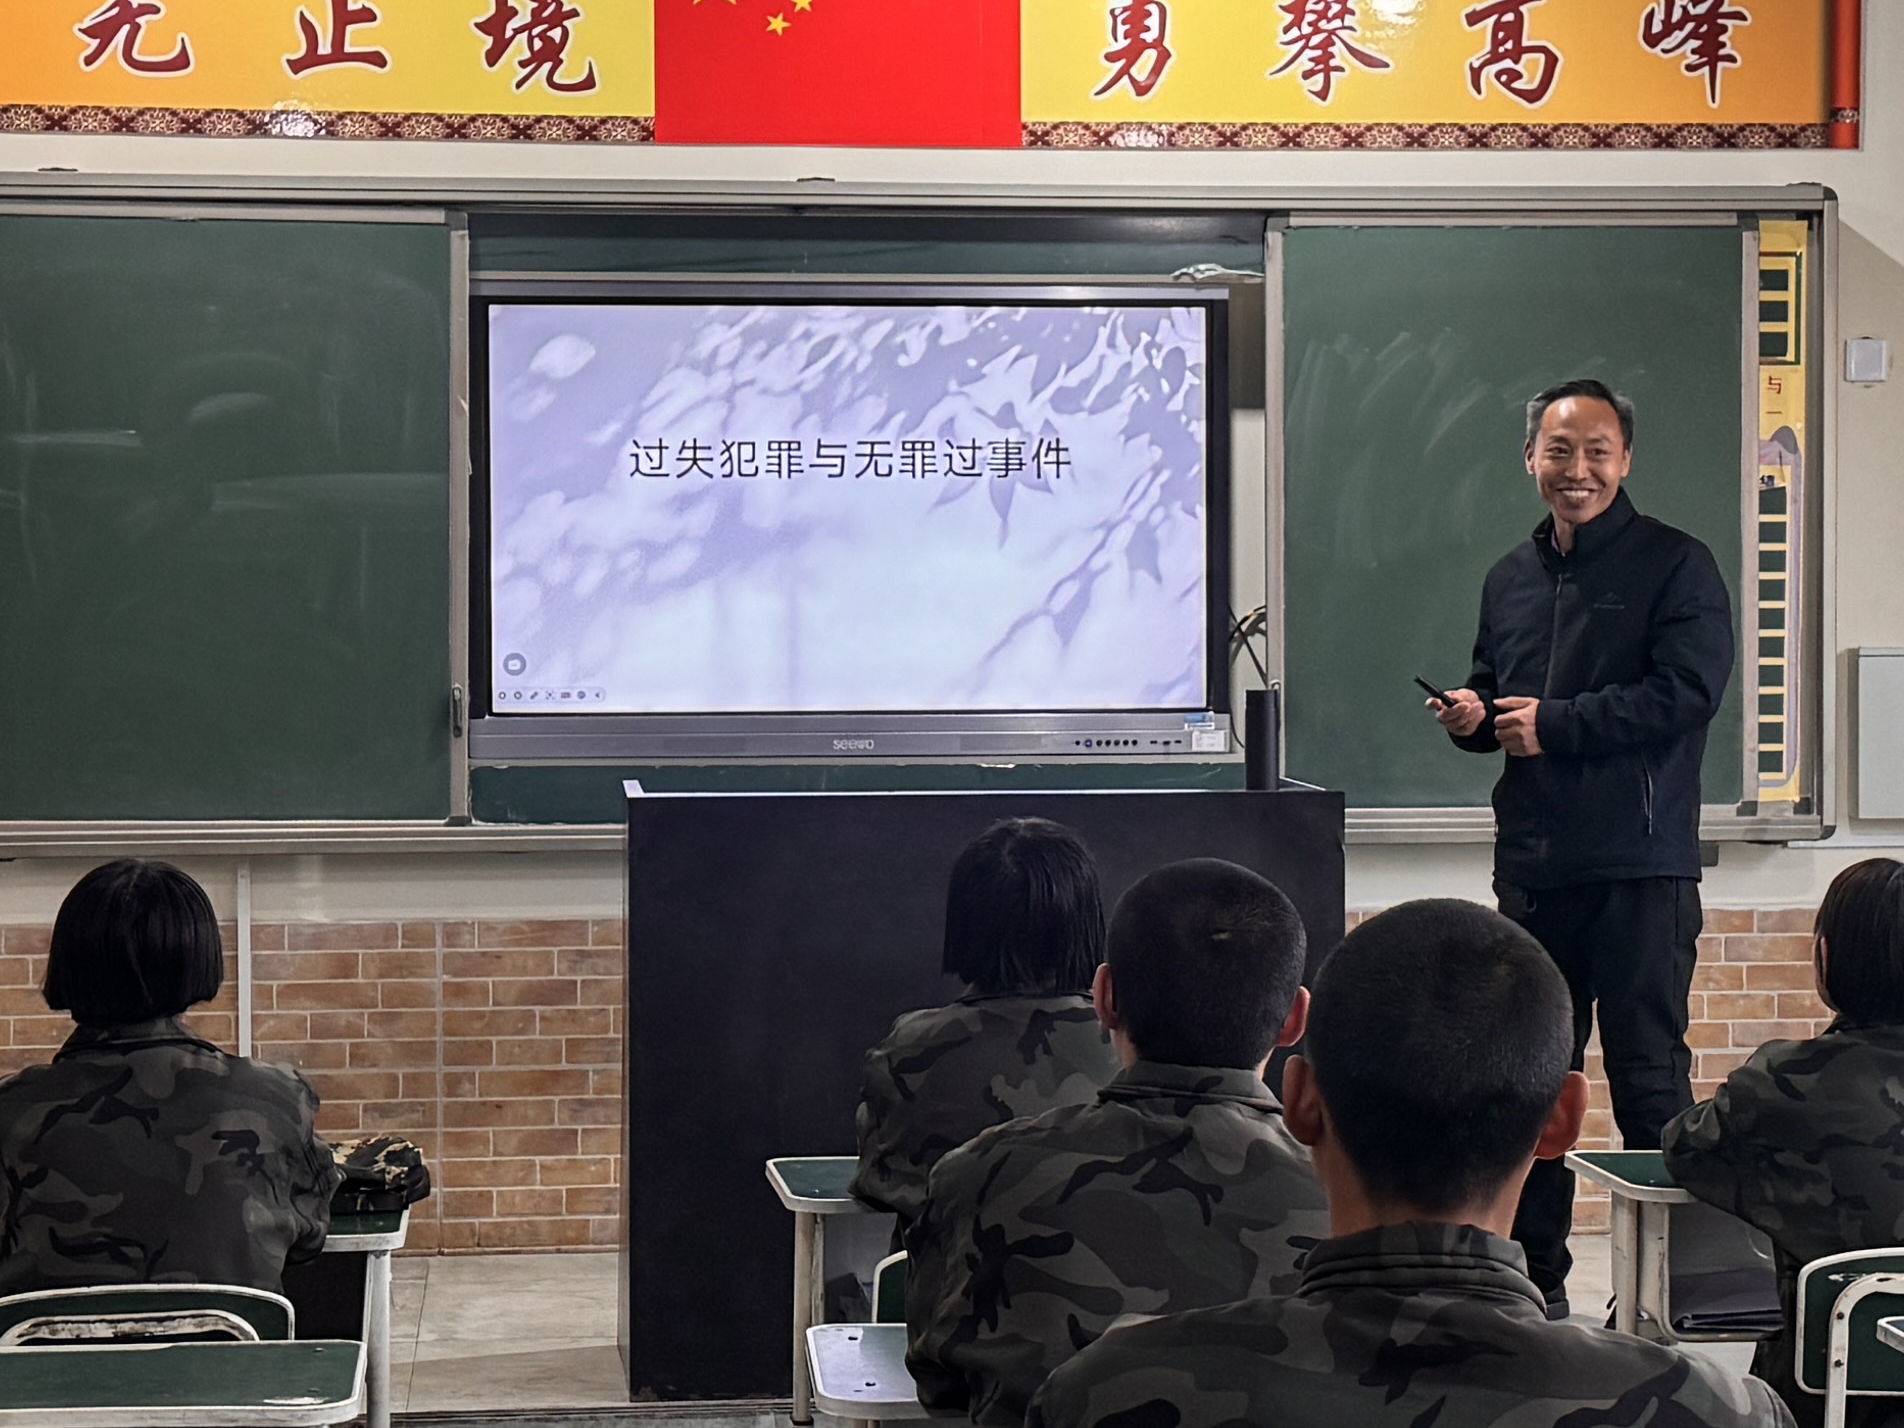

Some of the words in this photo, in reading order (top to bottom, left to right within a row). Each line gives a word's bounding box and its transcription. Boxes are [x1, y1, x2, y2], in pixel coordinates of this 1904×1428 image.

[628, 438, 1073, 480] 过失犯罪与无罪过事件
[833, 738, 875, 750] seewo
